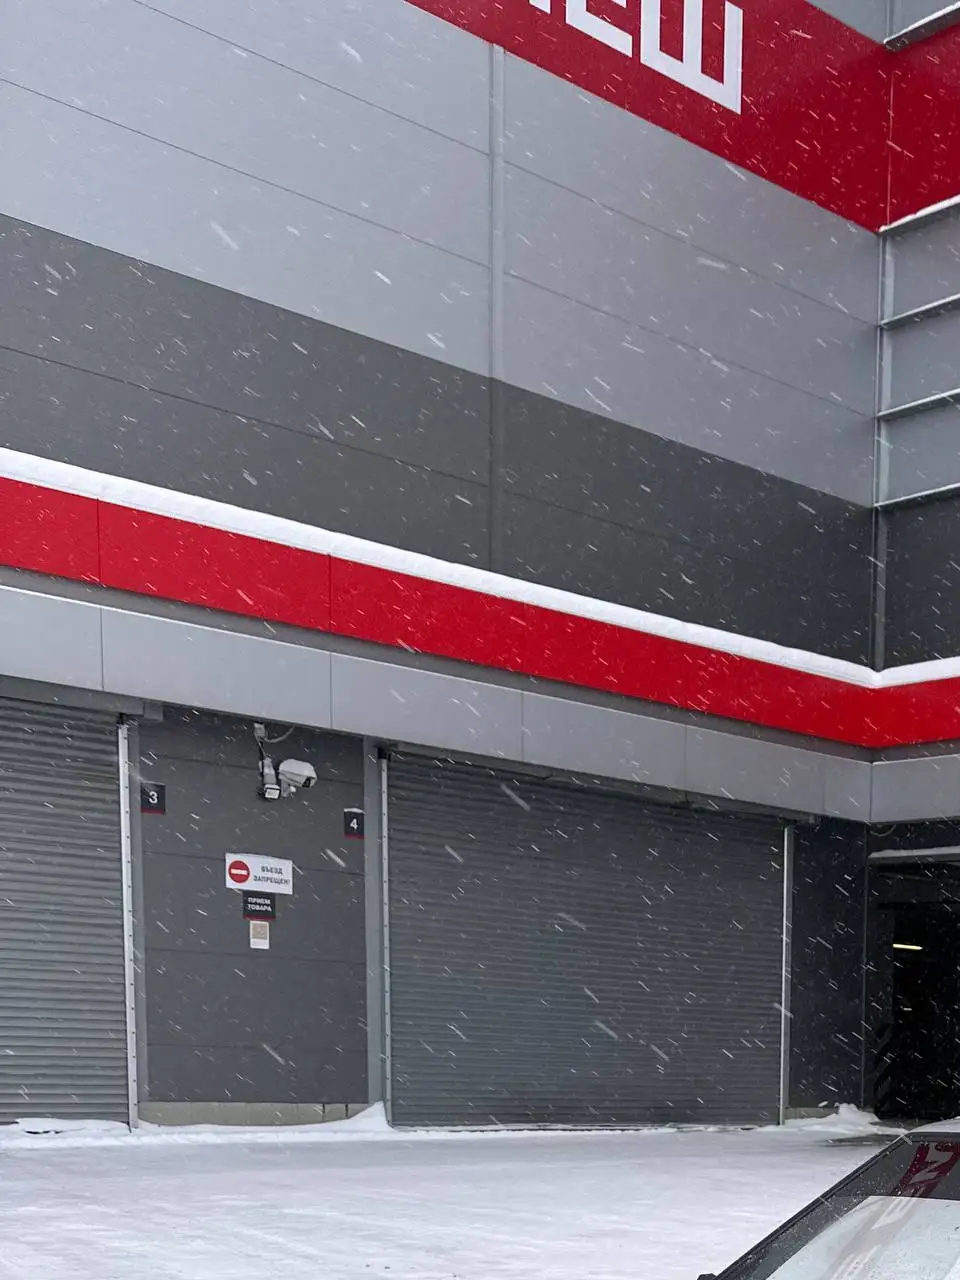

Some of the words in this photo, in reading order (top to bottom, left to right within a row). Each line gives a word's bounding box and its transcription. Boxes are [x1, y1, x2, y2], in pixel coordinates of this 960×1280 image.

[149, 791, 158, 804] 3
[350, 818, 358, 830] 4
[261, 866, 283, 875] ВЪЕЗД
[247, 903, 272, 912] ТОВАРА
